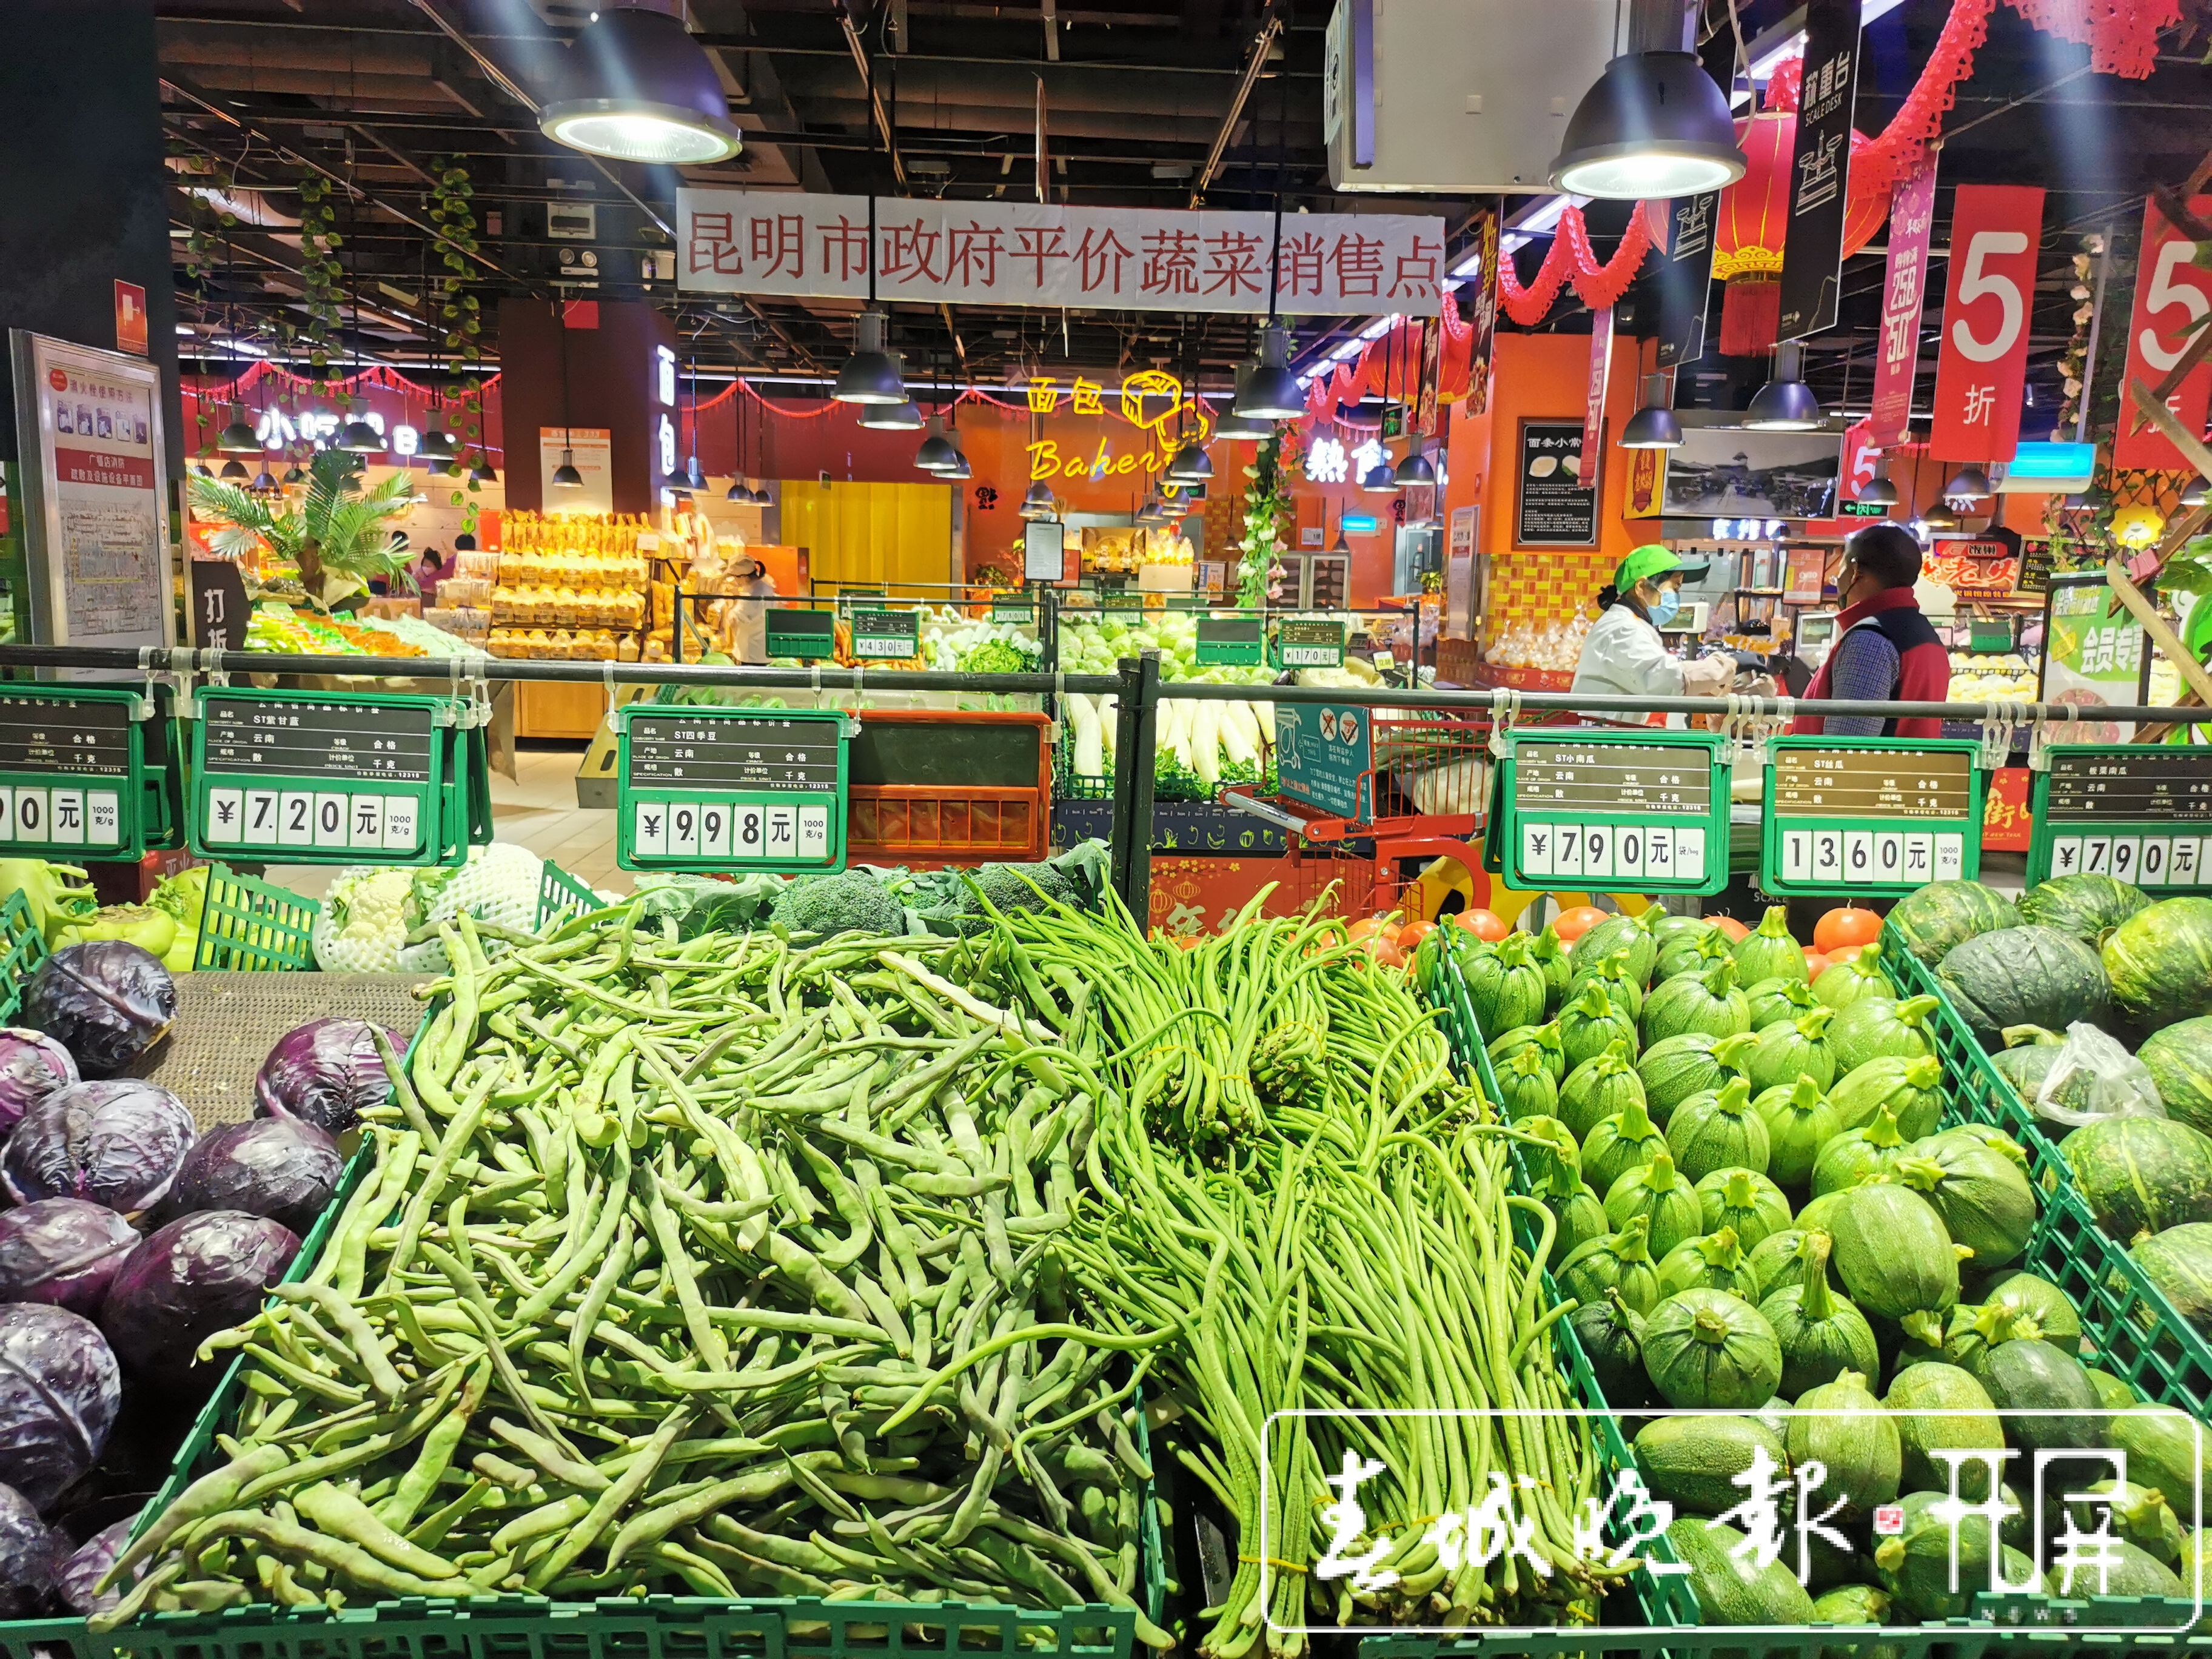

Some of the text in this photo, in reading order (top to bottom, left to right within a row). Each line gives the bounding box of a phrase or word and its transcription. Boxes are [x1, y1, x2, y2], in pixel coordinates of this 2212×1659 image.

[1803, 50, 1850, 111] 称重台
[689, 210, 1442, 299] 昆明市政府平价蔬菜销售点
[1890, 266, 1917, 312] 258
[1952, 232, 2028, 362] 5
[1028, 376, 1104, 415] 面包
[657, 344, 675, 475] 面包
[1963, 384, 1996, 427] 折
[253, 714, 300, 726] ST紫甘蓝
[73, 734, 96, 744] 合格
[253, 734, 275, 744] 云南
[674, 731, 717, 741] ST四季豆
[374, 739, 396, 750] 合格
[73, 753, 96, 763] 千克
[674, 748, 694, 759] 云南
[785, 752, 806, 762] 合格
[329, 754, 395, 769] 计价单位 千克
[1555, 754, 1595, 764] ST小南瓜
[1814, 760, 1843, 769] ST丝瓜
[674, 766, 683, 777] 散
[785, 771, 806, 781] 千克
[1555, 771, 1574, 781] 云南
[2090, 766, 2127, 776] 板栗南瓜
[1660, 775, 1680, 785] 合格
[1814, 777, 1833, 786] 云南
[1918, 780, 1939, 789] 合格
[2088, 784, 2106, 793] 云南
[2190, 784, 2210, 793] 合格
[1555, 789, 1564, 799] 散
[1660, 793, 1680, 802] 千克
[1918, 797, 1938, 808] 千克
[2188, 802, 2207, 810] 千克
[95, 816, 114, 826] 克/g
[390, 815, 411, 823] 1000
[390, 825, 409, 835] 克/g
[805, 830, 823, 839] 克/g
[1678, 846, 1698, 856] 袋/bag
[1792, 838, 1925, 869] 13.60元
[1941, 857, 1957, 865] 克/g
